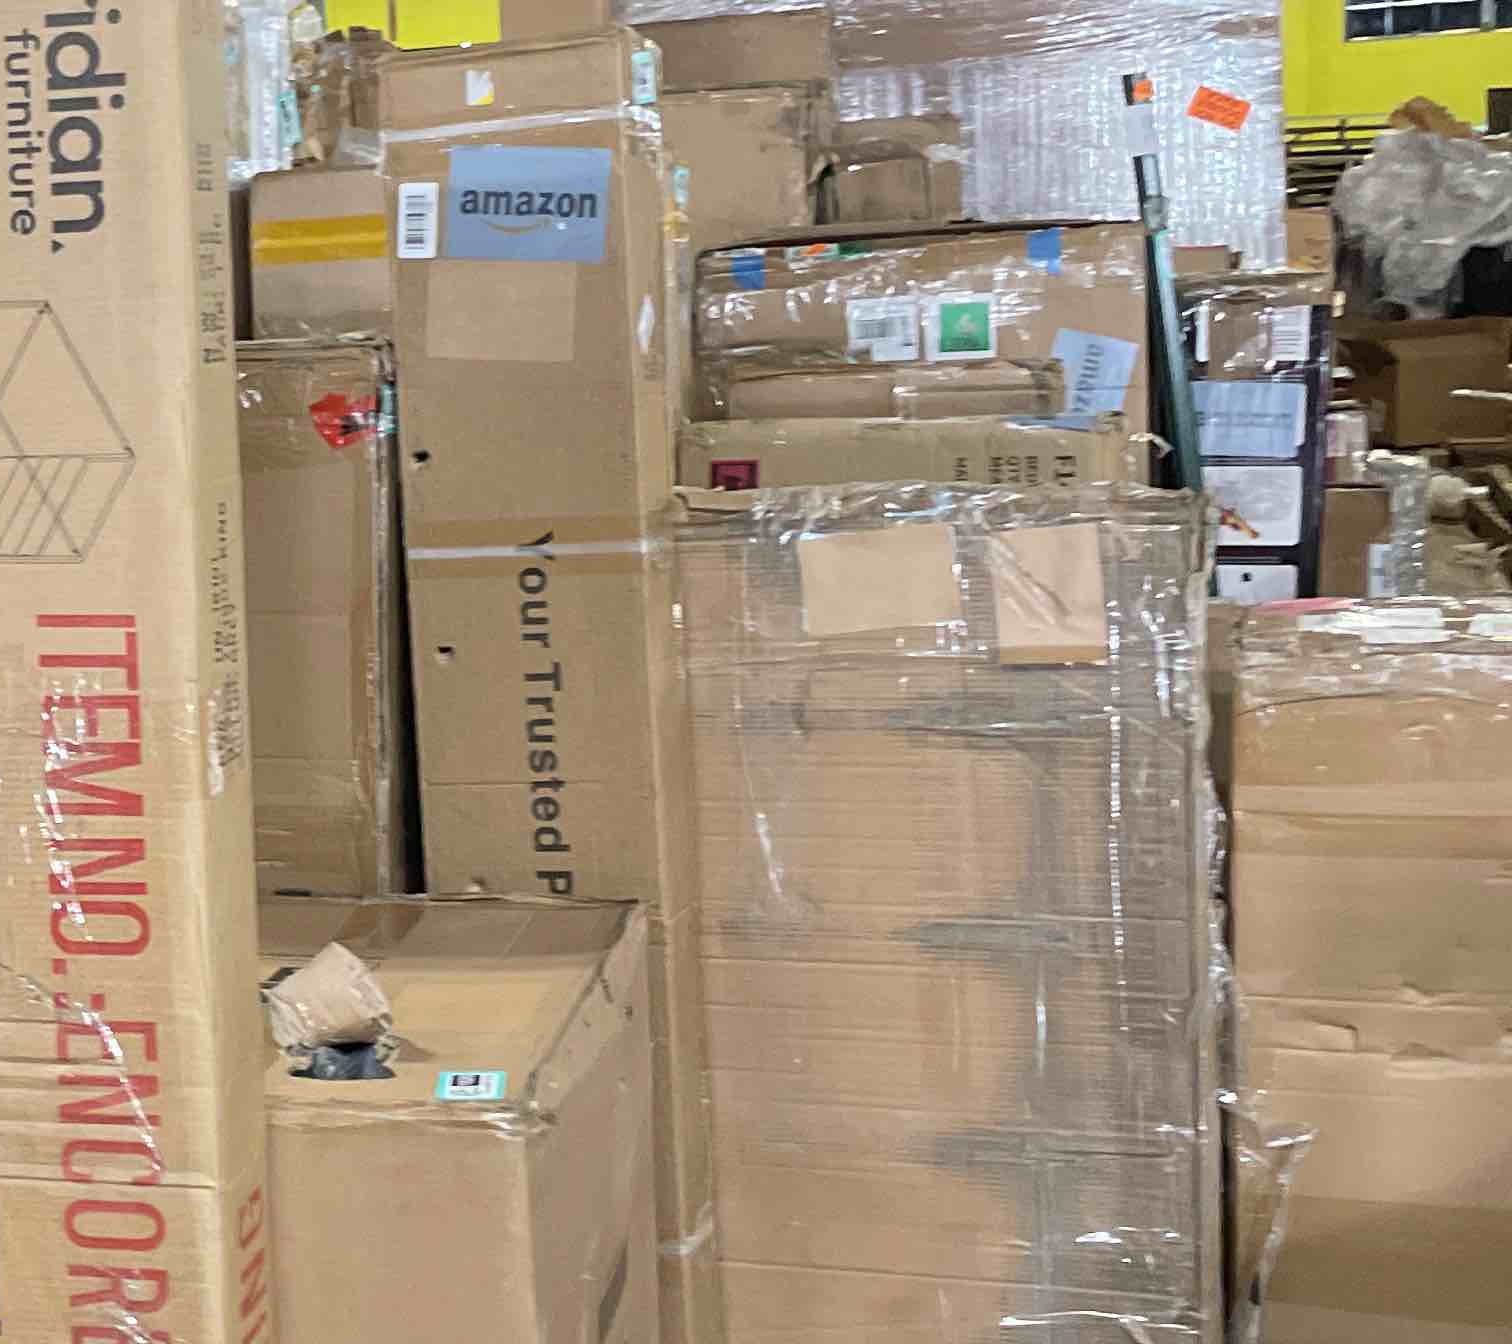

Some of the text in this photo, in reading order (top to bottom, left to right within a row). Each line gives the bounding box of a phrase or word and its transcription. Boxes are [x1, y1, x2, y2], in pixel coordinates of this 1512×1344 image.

[4, 27, 45, 236] furniture
[459, 188, 598, 219] amazon
[516, 531, 555, 648] Your
[36, 613, 145, 817] ITEM
[524, 662, 571, 854] Trusted
